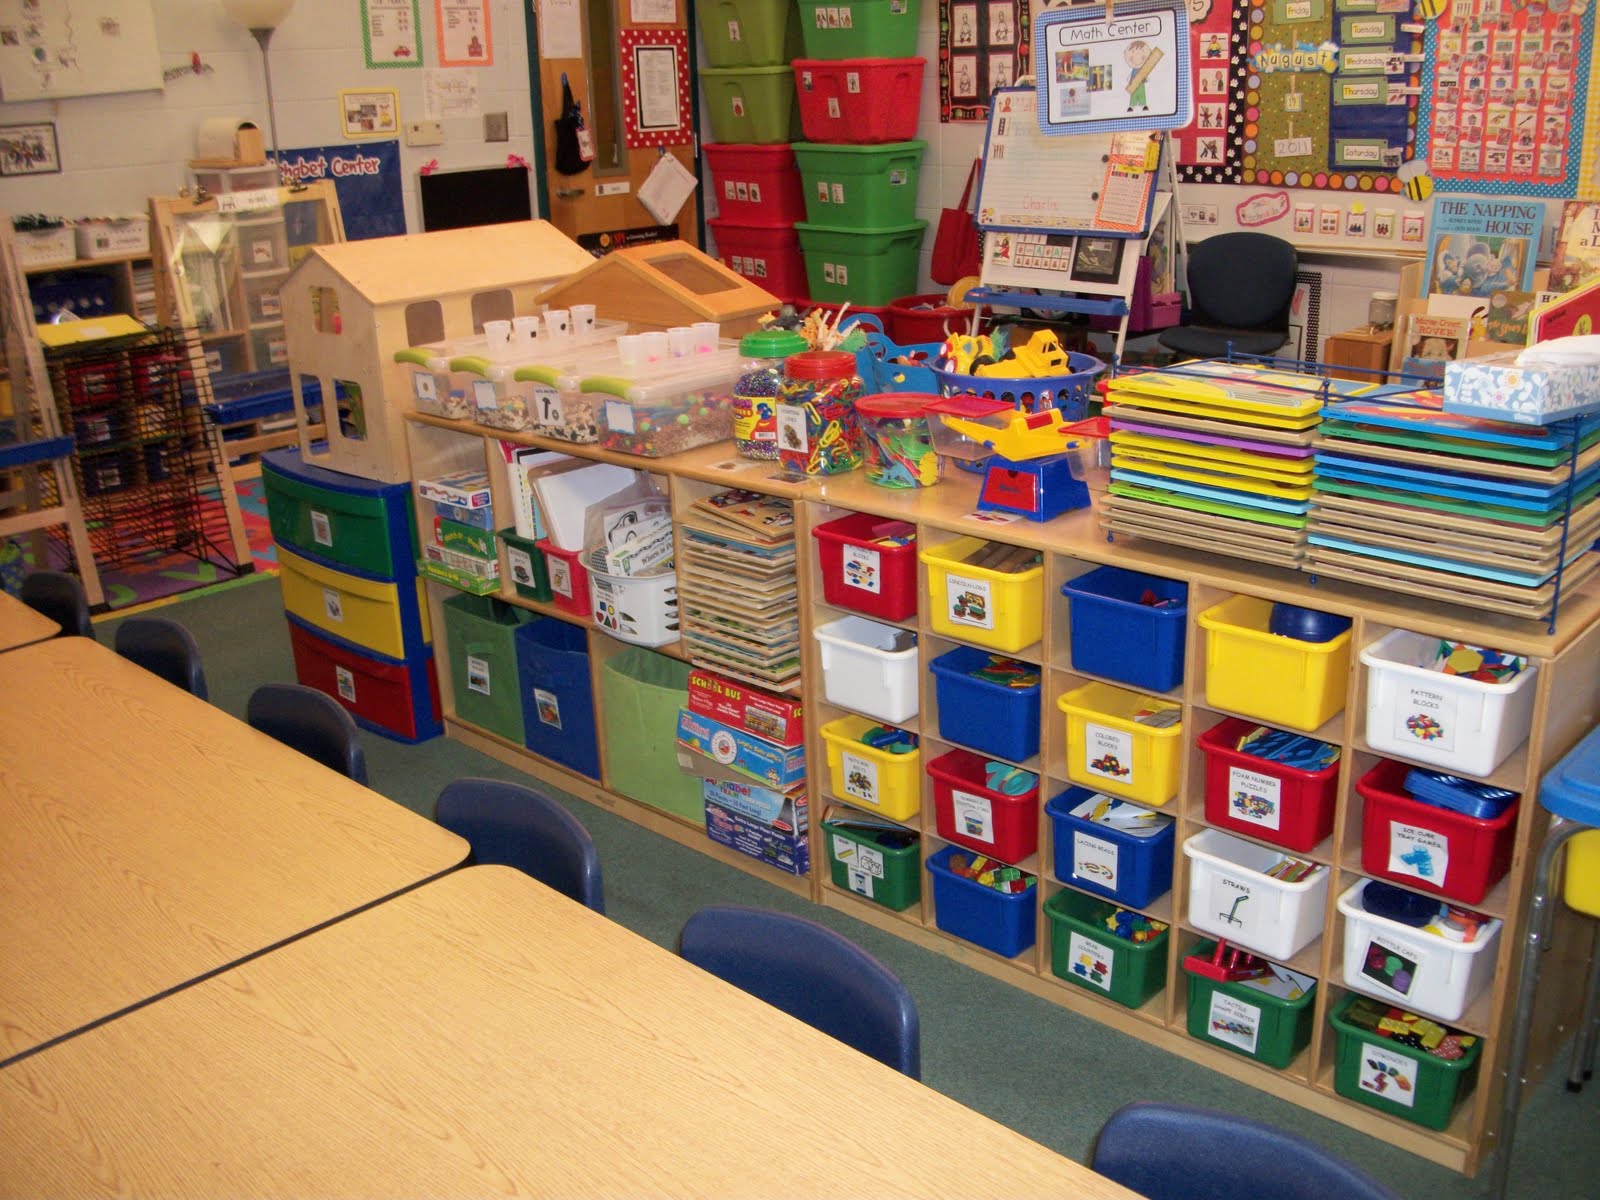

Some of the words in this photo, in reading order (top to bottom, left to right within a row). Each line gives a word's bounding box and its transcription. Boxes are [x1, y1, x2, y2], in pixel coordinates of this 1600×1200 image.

[1287, 6, 1310, 18] Friday
[1070, 27, 1103, 41] Math
[1107, 21, 1150, 36] Center
[1353, 25, 1384, 36] Tuesday
[1259, 53, 1328, 68] August
[1343, 86, 1378, 97] Thursday
[1277, 139, 1308, 154] 2011
[1345, 148, 1378, 160] Saturday
[331, 154, 380, 177] Center
[1440, 201, 1469, 216] THE
[1473, 202, 1537, 220] NAPPING
[1485, 220, 1534, 236] HOUSE
[1415, 317, 1438, 327] Move
[1419, 327, 1456, 337] ROVER!
[692, 676, 723, 694] SCHOOL
[725, 687, 742, 701] BUS
[1410, 688, 1442, 701] PATTERN
[1413, 698, 1439, 710] BLOCKS
[1095, 732, 1120, 743] COLORED
[1097, 741, 1118, 750] BLOCKS
[1232, 770, 1251, 782] FOAM
[1251, 775, 1277, 788] NUMBER
[1240, 781, 1268, 793] PUZZLES
[1398, 832, 1416, 842] TRAY
[1417, 837, 1442, 849] GAMES
[1417, 830, 1435, 840] CUBE
[1076, 837, 1097, 850] LACING
[1096, 844, 1115, 857] BEADS
[1222, 878, 1251, 894] STRAWS
[1376, 936, 1401, 951] BOTTLE
[1400, 945, 1419, 960] CAPS
[1213, 1003, 1234, 1015] SHAPE
[1223, 999, 1248, 1013] TACTILE
